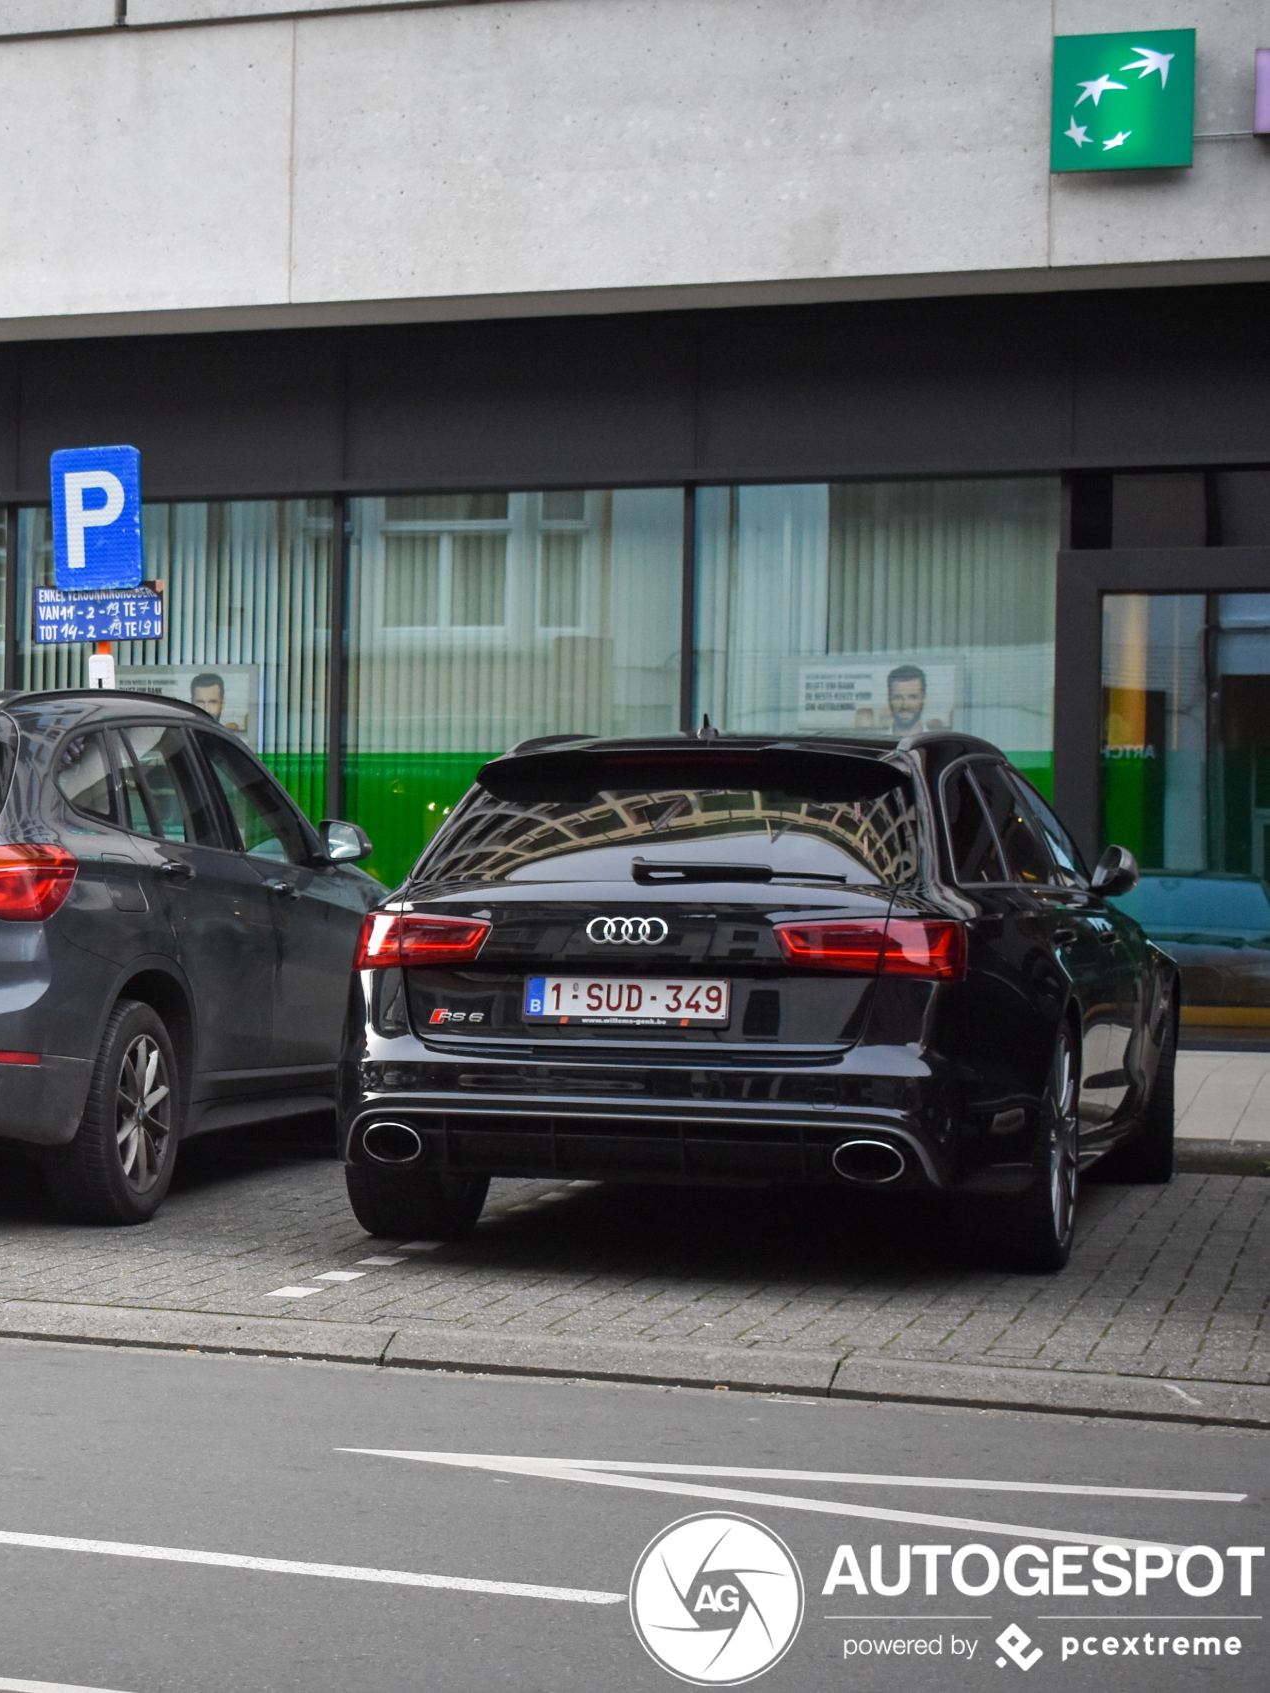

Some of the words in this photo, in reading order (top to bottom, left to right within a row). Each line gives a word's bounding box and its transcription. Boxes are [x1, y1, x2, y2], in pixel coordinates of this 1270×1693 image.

[64, 470, 124, 568] P
[39, 588, 66, 603] ENKEL
[39, 605, 59, 620] VAN
[123, 602, 136, 616] TE
[138, 601, 150, 614] 7
[154, 601, 162, 615] U
[39, 625, 58, 640] TOT
[124, 622, 137, 637] TE
[154, 621, 162, 635] U
[530, 999, 541, 1012] B
[581, 1018, 667, 1026] www.willems-genk.be
